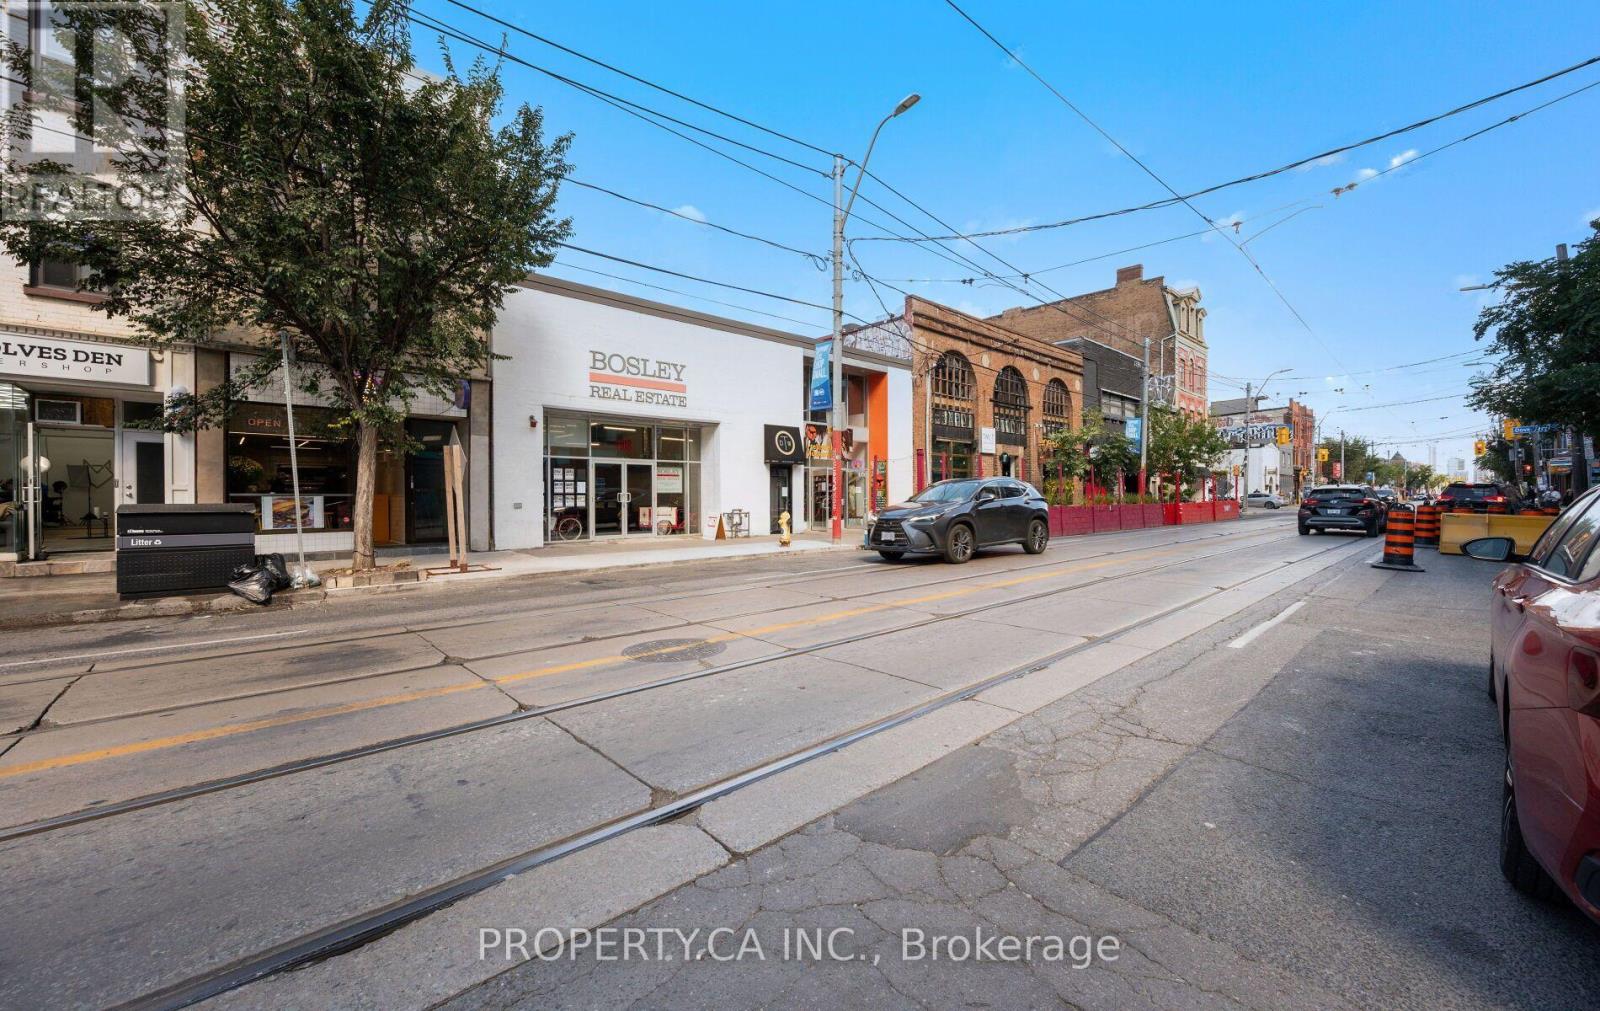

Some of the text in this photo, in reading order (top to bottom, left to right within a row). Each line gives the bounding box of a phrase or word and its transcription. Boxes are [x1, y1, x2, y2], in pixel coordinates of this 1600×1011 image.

[0, 342, 124, 367] LVES DEN
[589, 350, 687, 382] BOSLEY
[589, 385, 687, 407] REAL ESTATE
[248, 417, 281, 427] OPEN
[131, 538, 152, 546] Litter
